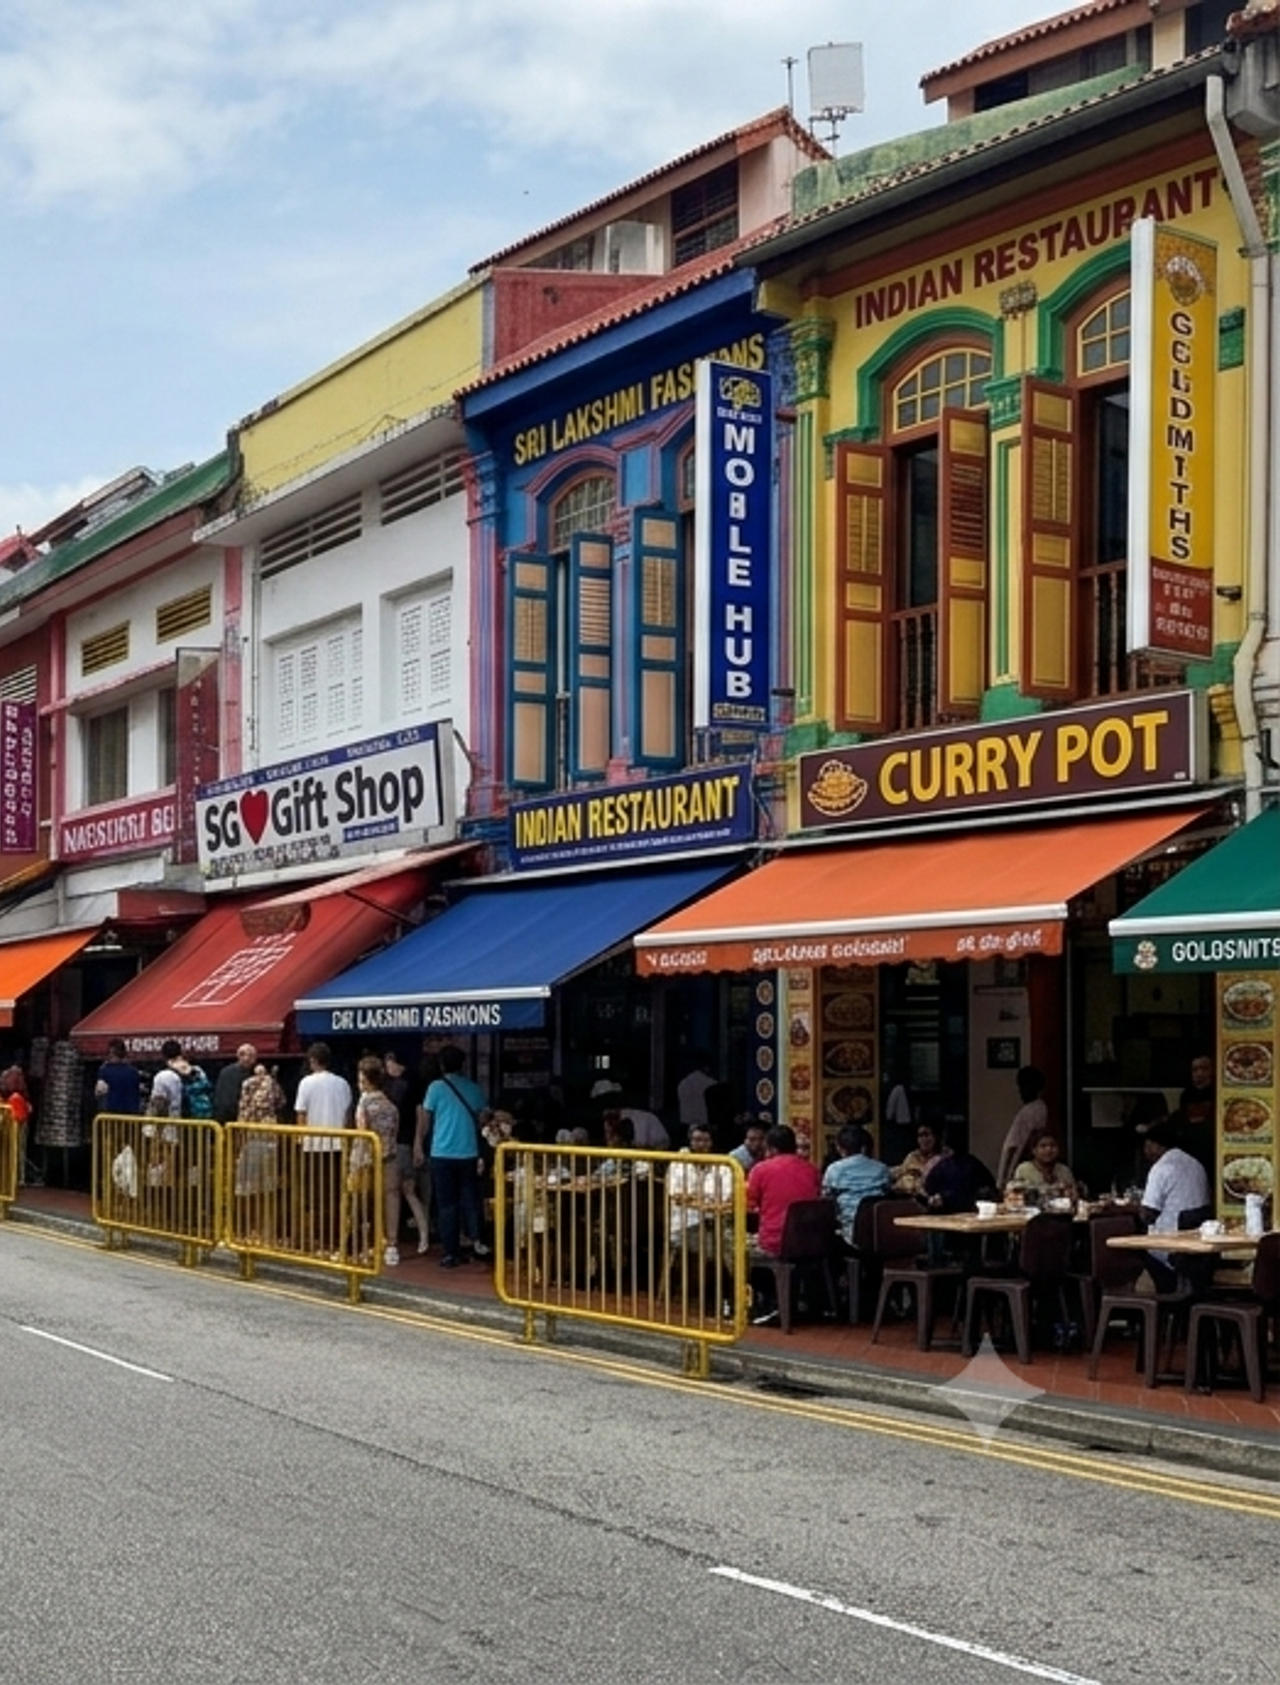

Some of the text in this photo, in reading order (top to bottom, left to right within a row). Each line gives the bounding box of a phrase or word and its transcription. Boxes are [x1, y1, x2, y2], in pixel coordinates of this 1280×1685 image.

[855, 167, 1218, 329] INDIAN RESTAURANT
[514, 428, 546, 467] SRI
[552, 386, 644, 452] LAKSHMI
[726, 604, 753, 698] HUB
[879, 710, 1169, 806] CURRY POT
[205, 765, 425, 851] SG Gift Shop
[515, 802, 582, 849] INDIAN
[588, 776, 739, 839] RESTAURANT
